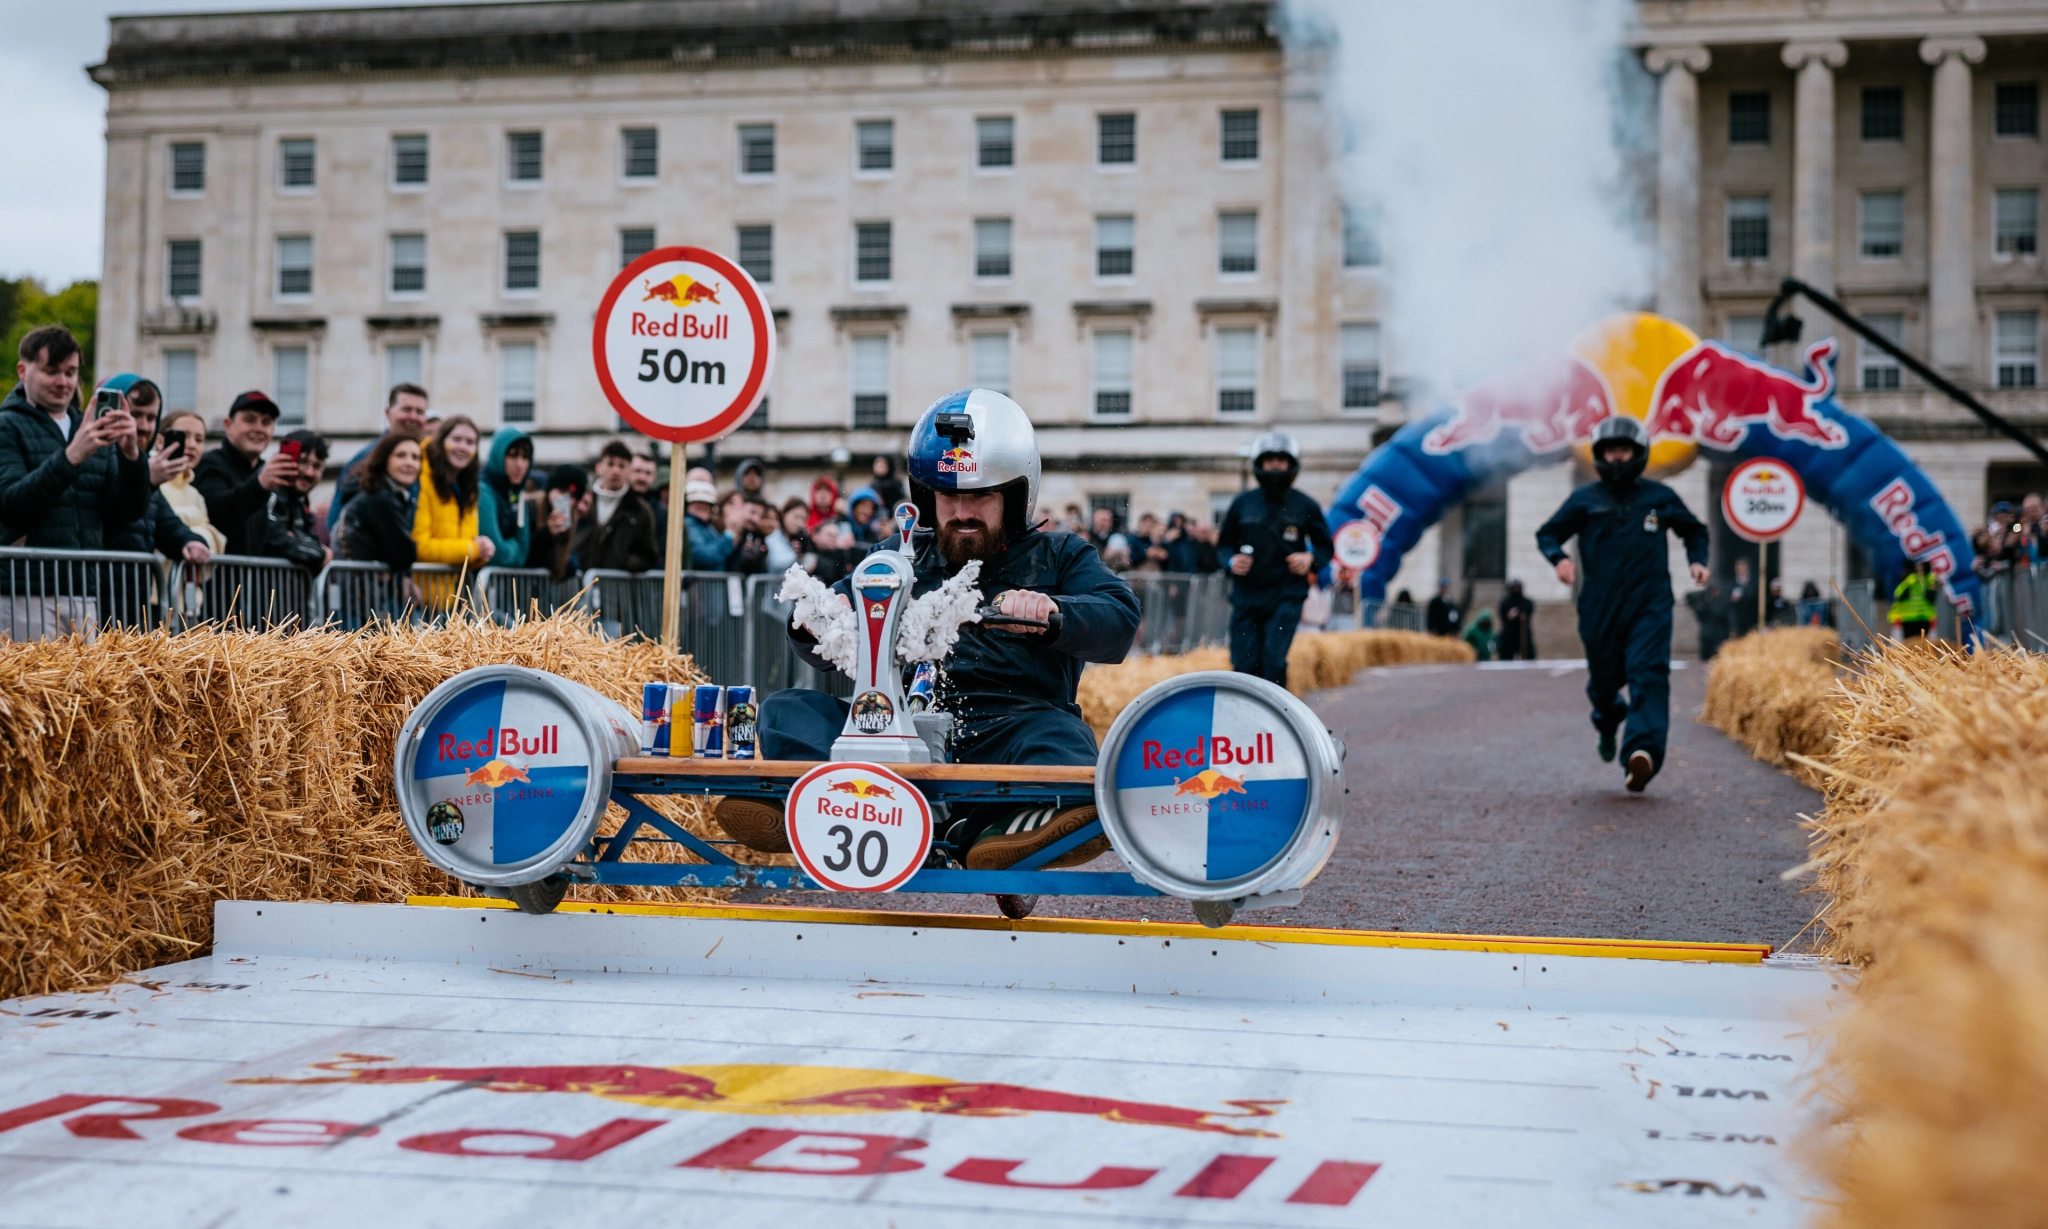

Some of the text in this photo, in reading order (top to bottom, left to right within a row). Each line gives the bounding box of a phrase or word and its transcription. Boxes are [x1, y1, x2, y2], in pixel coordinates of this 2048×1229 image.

[631, 312, 728, 339] Red Bull
[638, 348, 726, 385] 50m
[938, 461, 977, 472] Red Bull
[1744, 498, 1786, 514] 30m
[1874, 480, 1942, 556] Red
[438, 725, 558, 762] Red Bull
[1142, 732, 1274, 770] Red Bull
[508, 787, 555, 801] DRINK
[1151, 799, 1269, 816] ENERGY DRINK
[817, 797, 902, 826] Red Bull
[823, 824, 888, 877] 30
[0, 1093, 1384, 1206] Red Bull
